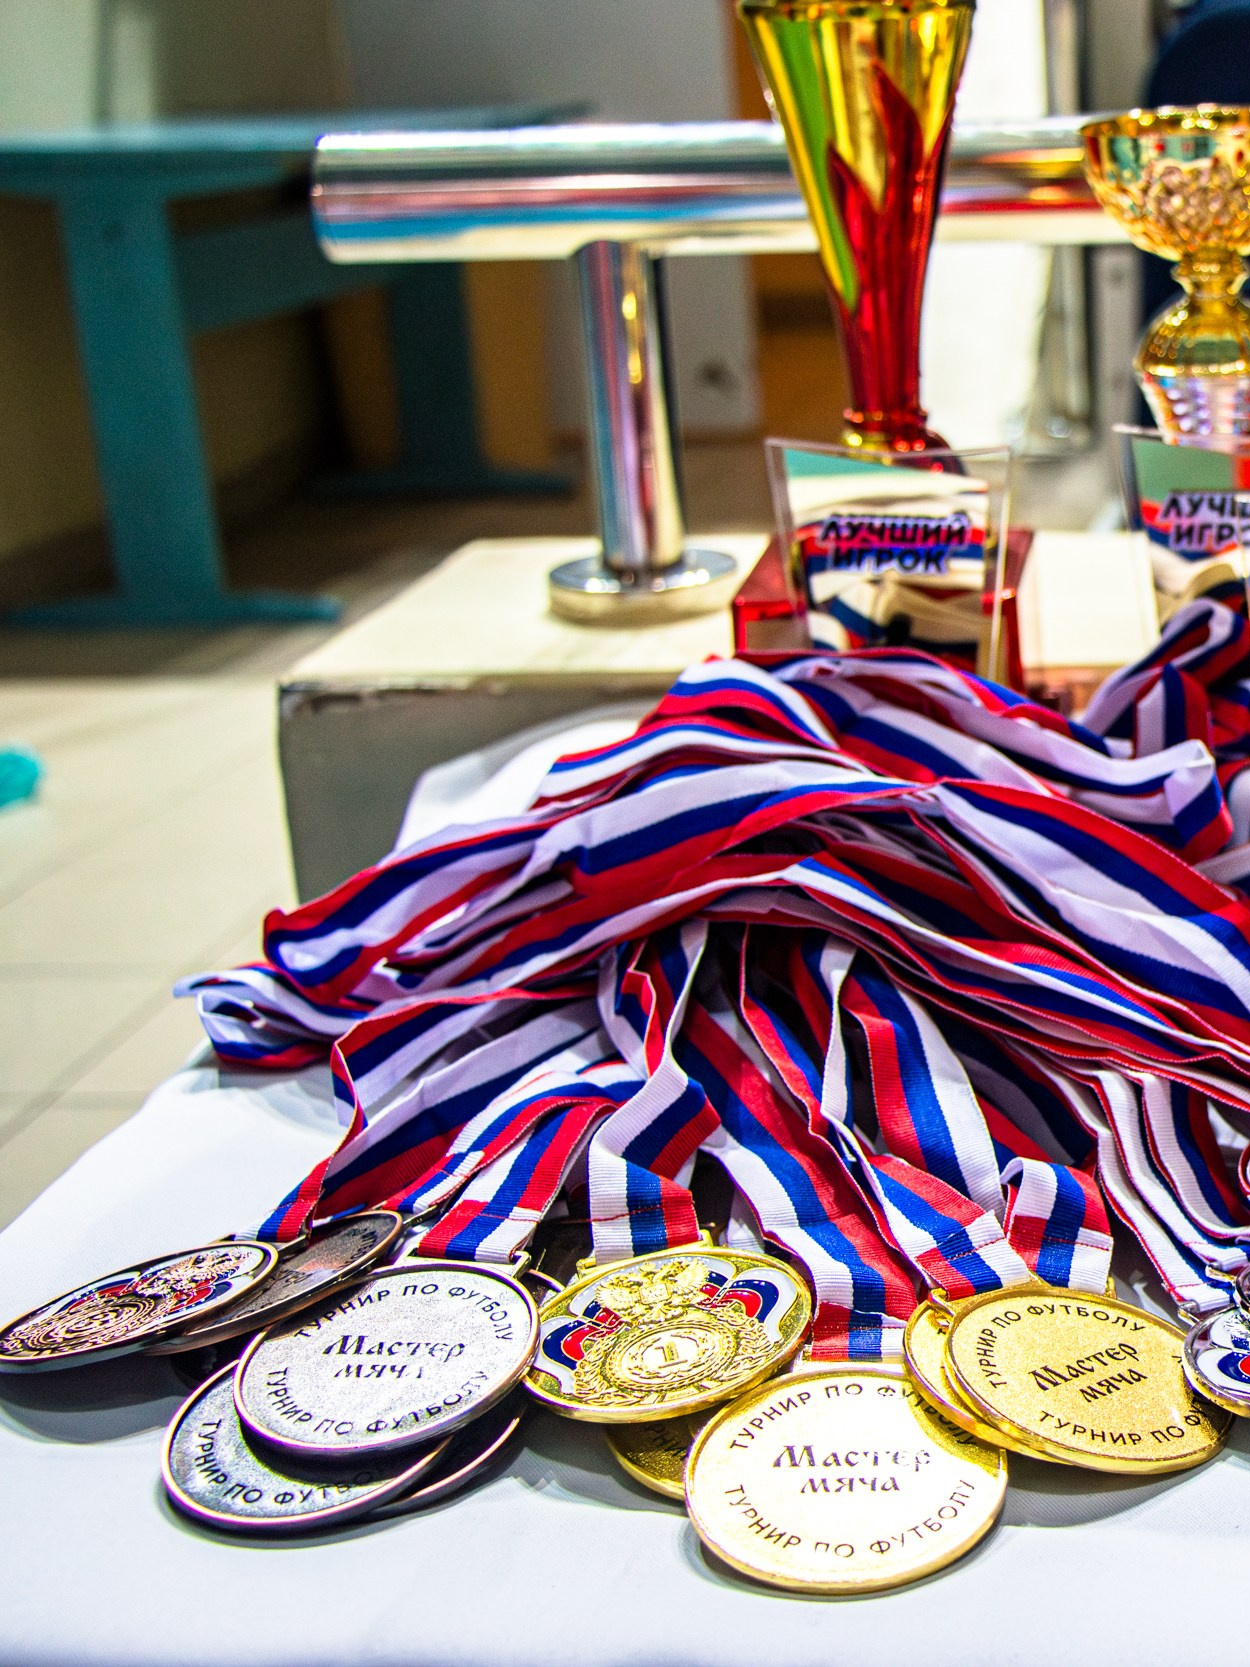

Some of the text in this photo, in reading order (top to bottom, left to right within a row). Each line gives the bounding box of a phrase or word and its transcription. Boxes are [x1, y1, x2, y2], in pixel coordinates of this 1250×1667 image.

[820, 511, 970, 546] ЛУЧШИЙ
[832, 547, 946, 573] ИГРОК
[294, 1283, 514, 1342] ТУРНИР ПО ФУТБОЛУ
[322, 1335, 466, 1363] Мастер
[977, 1303, 1146, 1389] ТУРНИР ПО ФУТБОЛУ
[1029, 1342, 1139, 1392] Мастер
[268, 1366, 313, 1425] ТУРНИР
[314, 1419, 354, 1436] ПО
[1080, 1367, 1149, 1403] мяча
[730, 1391, 812, 1450] ТУРНИР
[825, 1384, 863, 1398] ПО
[1039, 1410, 1142, 1446] ТУРНИР
[1150, 1424, 1186, 1444] ПО
[195, 1419, 374, 1505] ТУРНИР ПО ФУТБО
[801, 1476, 902, 1494] мяча
[724, 1479, 977, 1559] ТУРНИР ПО ФУТБОЛУ
